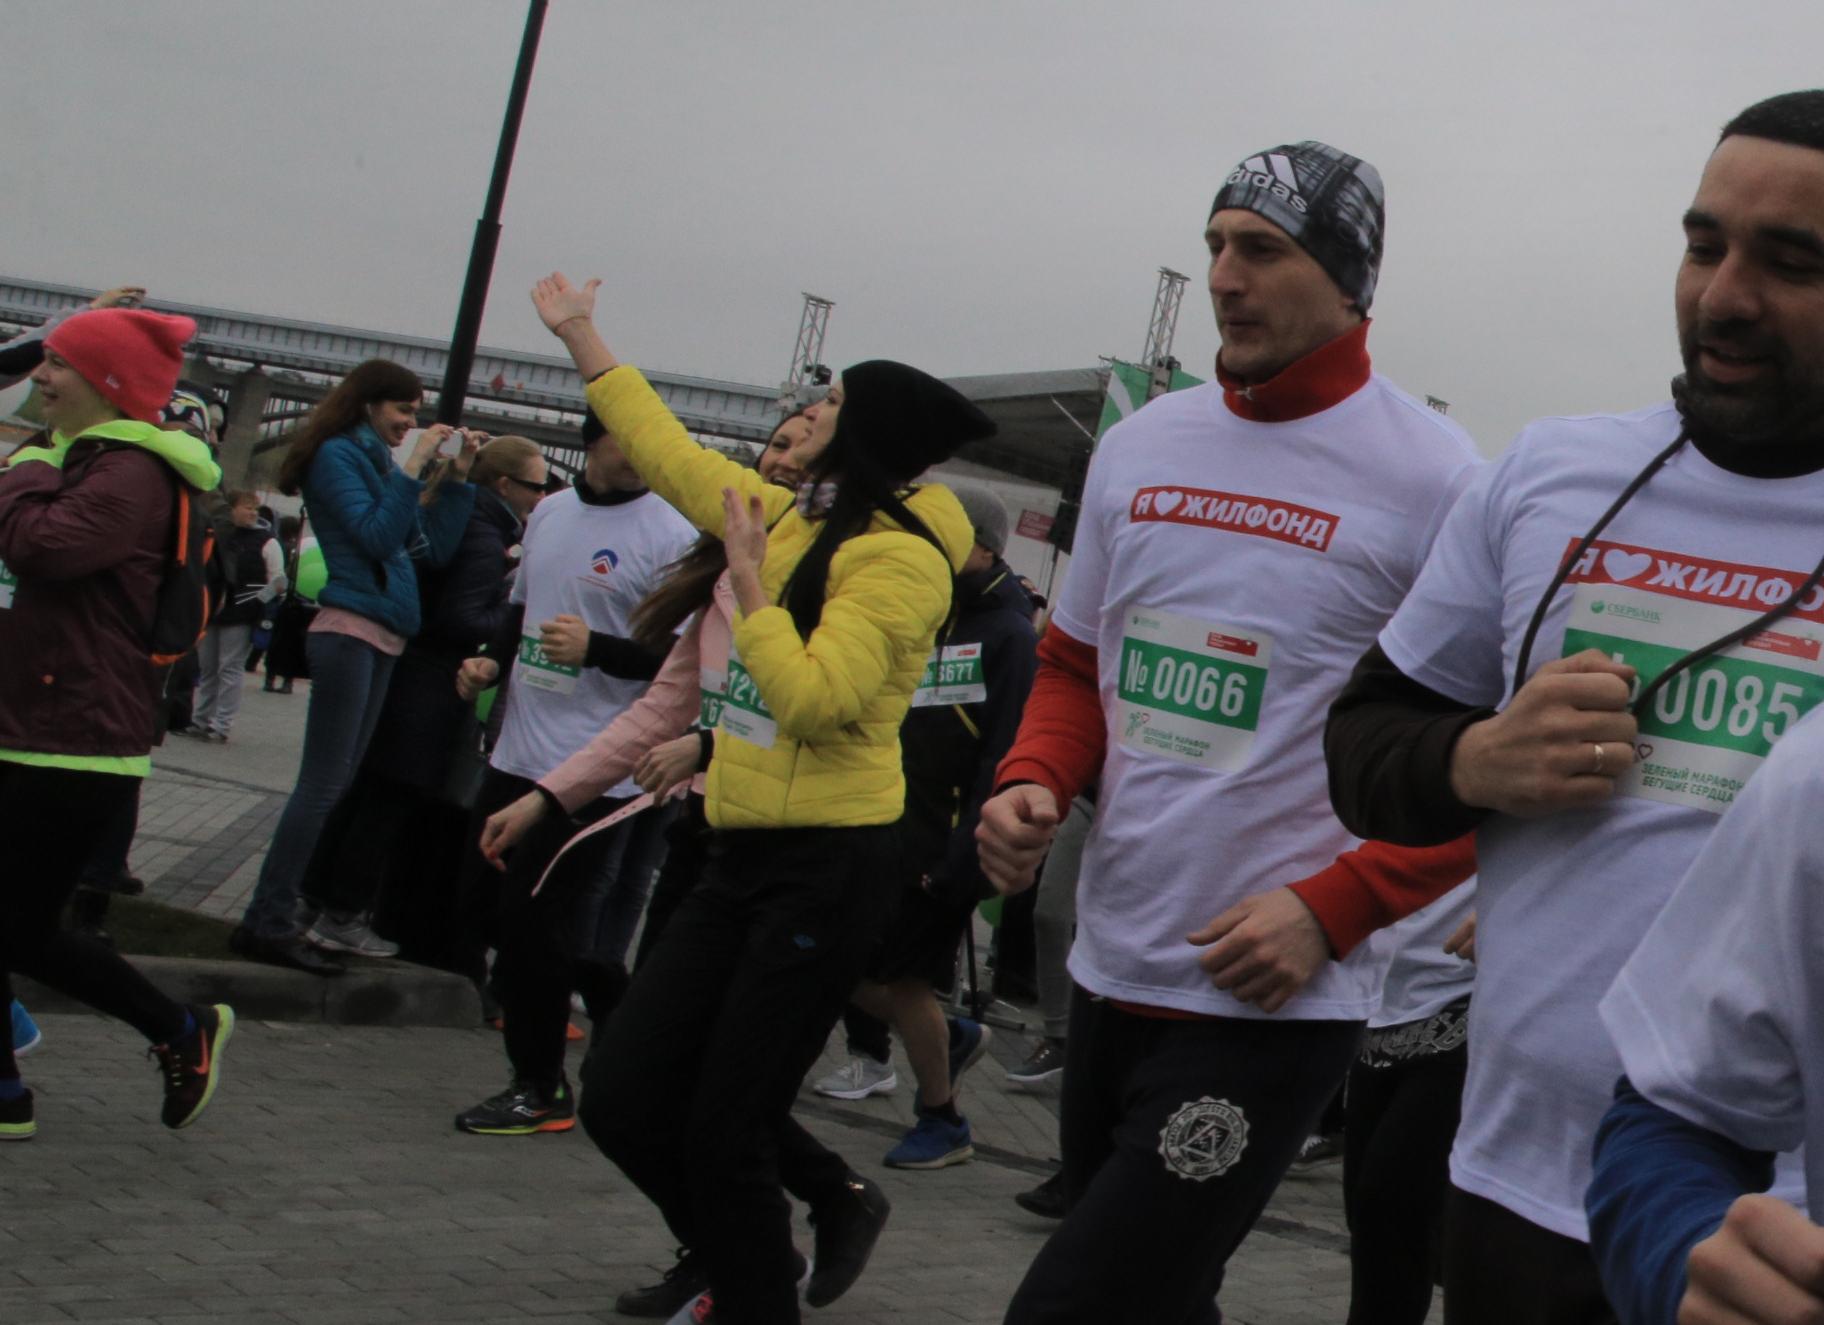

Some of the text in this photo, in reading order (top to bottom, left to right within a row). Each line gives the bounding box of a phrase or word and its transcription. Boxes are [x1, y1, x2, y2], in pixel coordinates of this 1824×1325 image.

[1227, 168, 1308, 213] didas
[1135, 493, 1330, 548] Я ЖИЛФОНД
[1607, 602, 1661, 621] СБЕРБАНК
[1152, 656, 1249, 718] 0066
[1654, 664, 1803, 746] 0085
